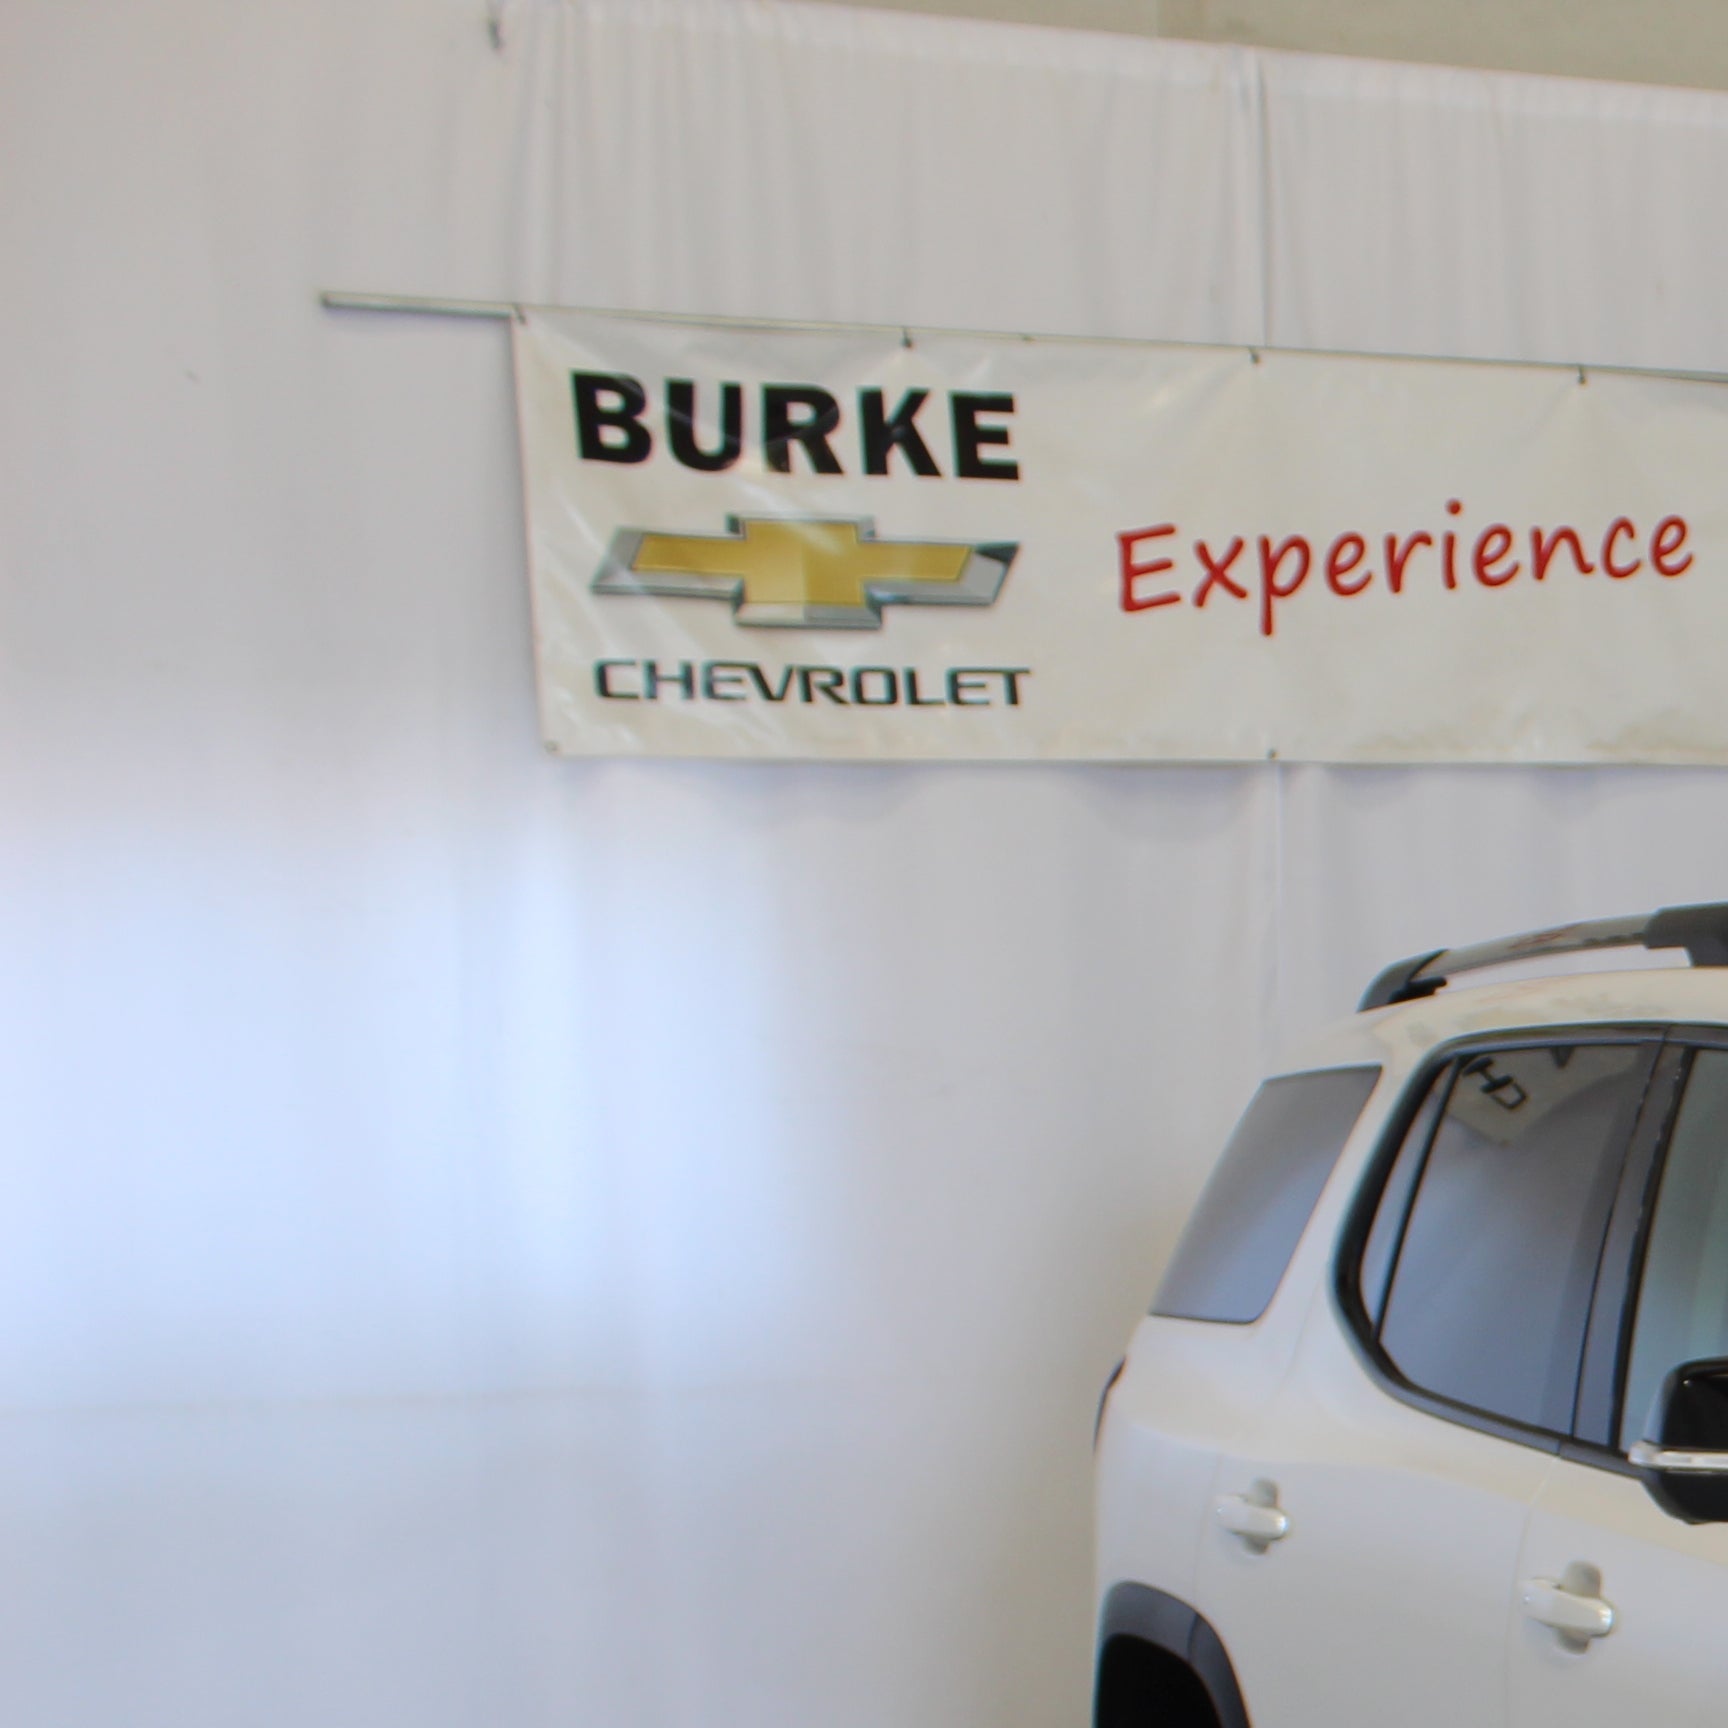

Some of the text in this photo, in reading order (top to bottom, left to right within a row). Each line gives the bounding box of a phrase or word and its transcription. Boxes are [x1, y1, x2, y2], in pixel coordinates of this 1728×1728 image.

[571, 370, 1020, 481] BURKE
[1116, 499, 1694, 636] Experience
[594, 658, 1031, 707] CHEVROLET
